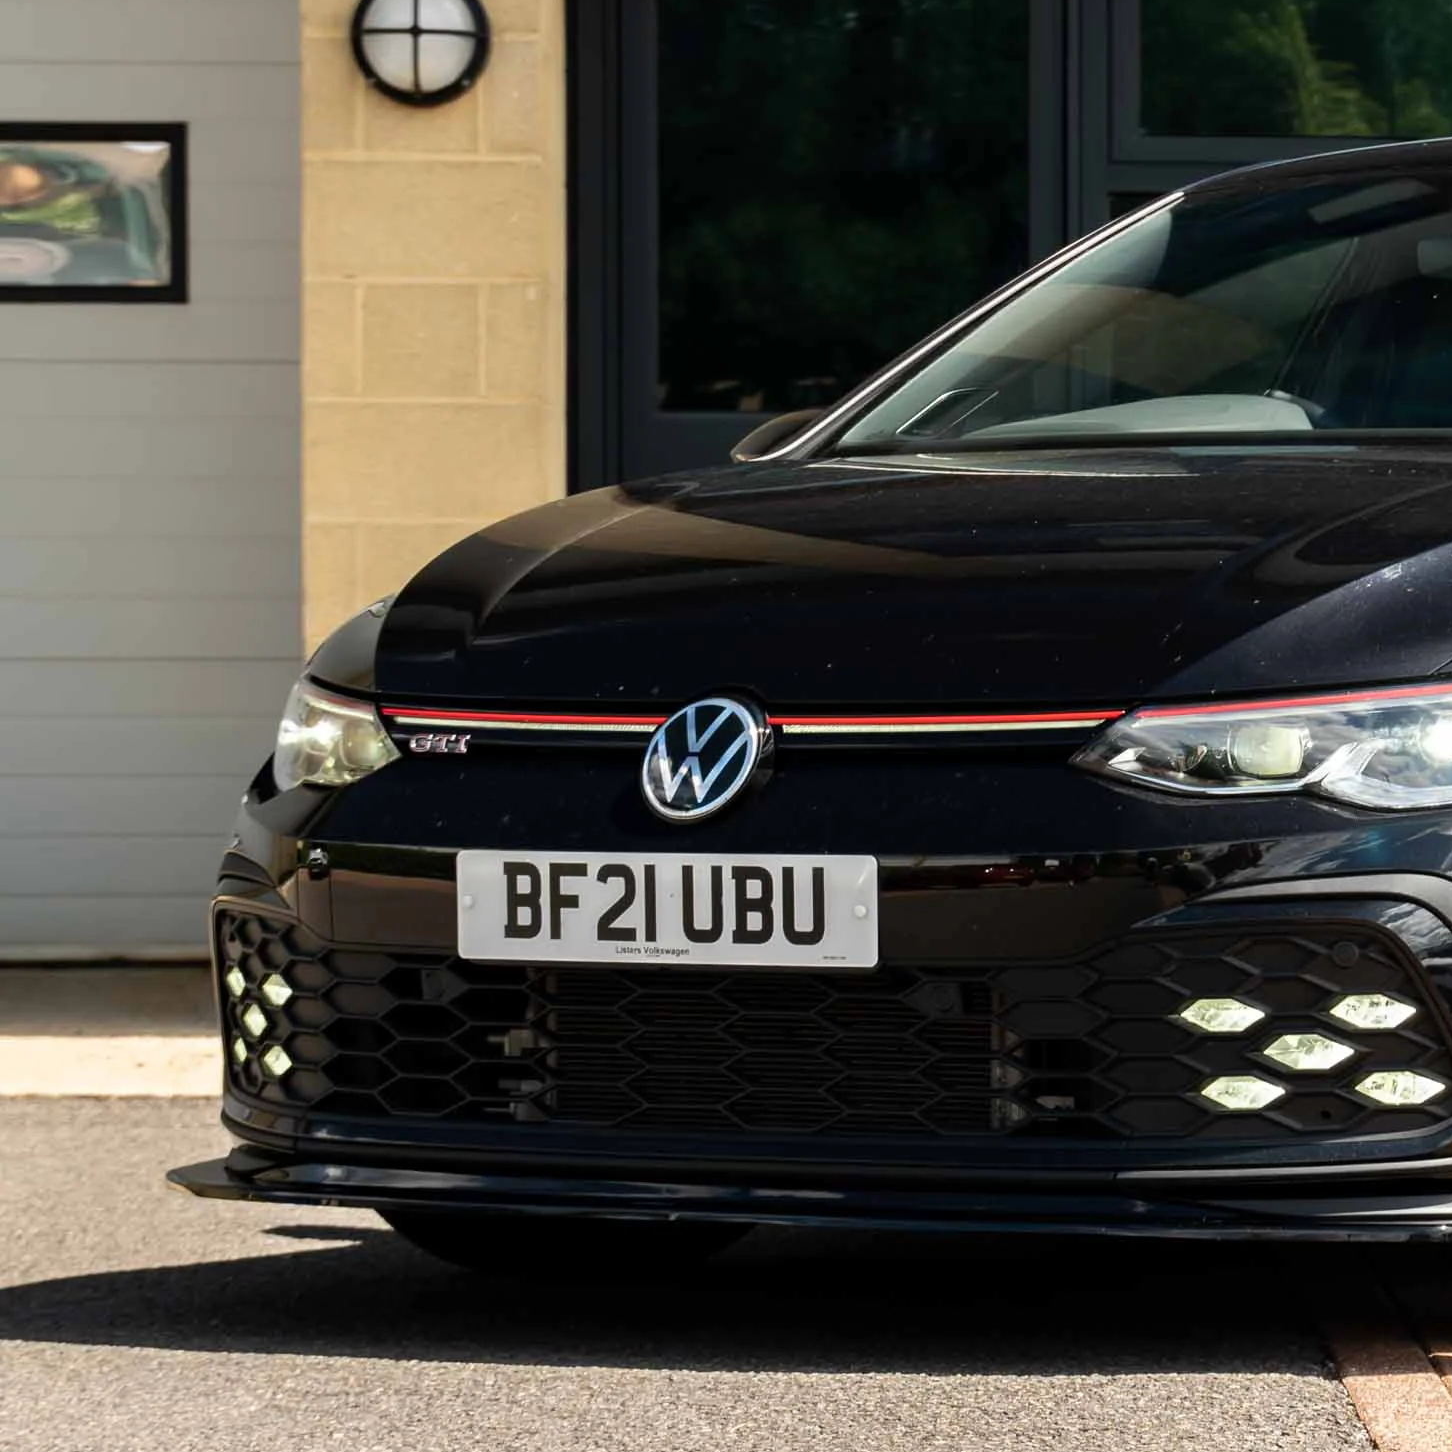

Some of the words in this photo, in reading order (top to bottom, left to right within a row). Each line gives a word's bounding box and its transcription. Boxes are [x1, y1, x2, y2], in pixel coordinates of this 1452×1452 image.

[409, 733, 472, 753] GTI
[649, 701, 754, 812] VW
[503, 861, 657, 942] BF21
[682, 864, 826, 945] UBU
[643, 946, 690, 957] Volkswagen
